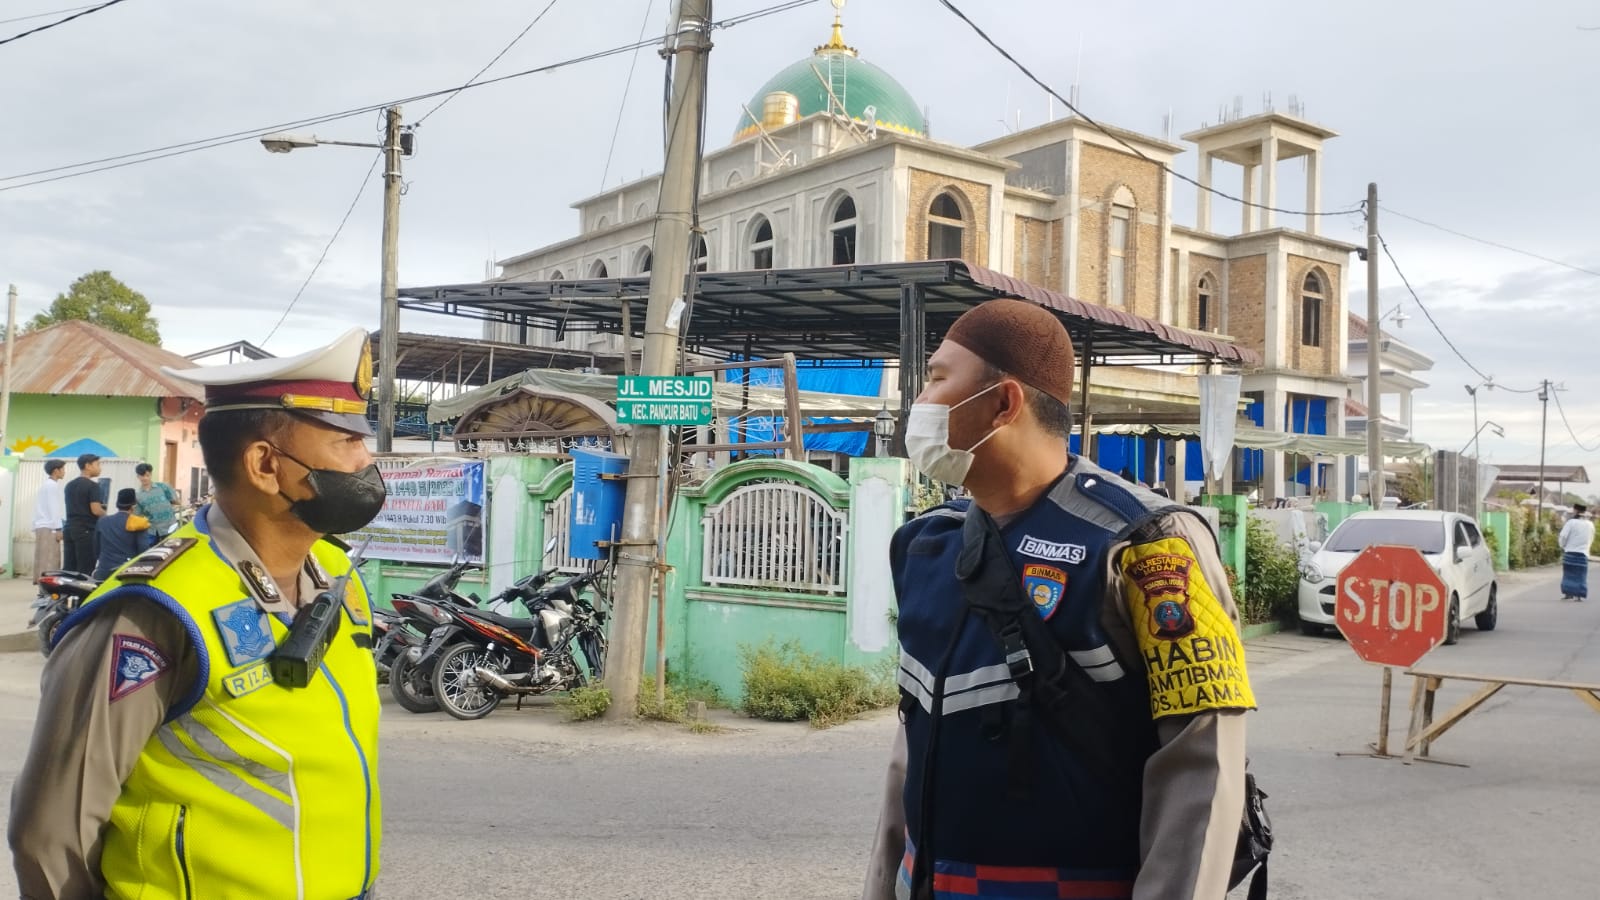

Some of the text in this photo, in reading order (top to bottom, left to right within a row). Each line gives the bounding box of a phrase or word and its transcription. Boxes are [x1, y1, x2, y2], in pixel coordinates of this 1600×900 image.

[620, 379, 711, 397] JL. MESJID
[631, 403, 699, 421] KEC. PANCUR BATU
[1023, 540, 1082, 561] BINMAS
[1031, 567, 1062, 581] BINMAS
[1143, 563, 1177, 576] MEDAN
[1343, 576, 1440, 633] STOP
[1144, 635, 1238, 674] HABIN
